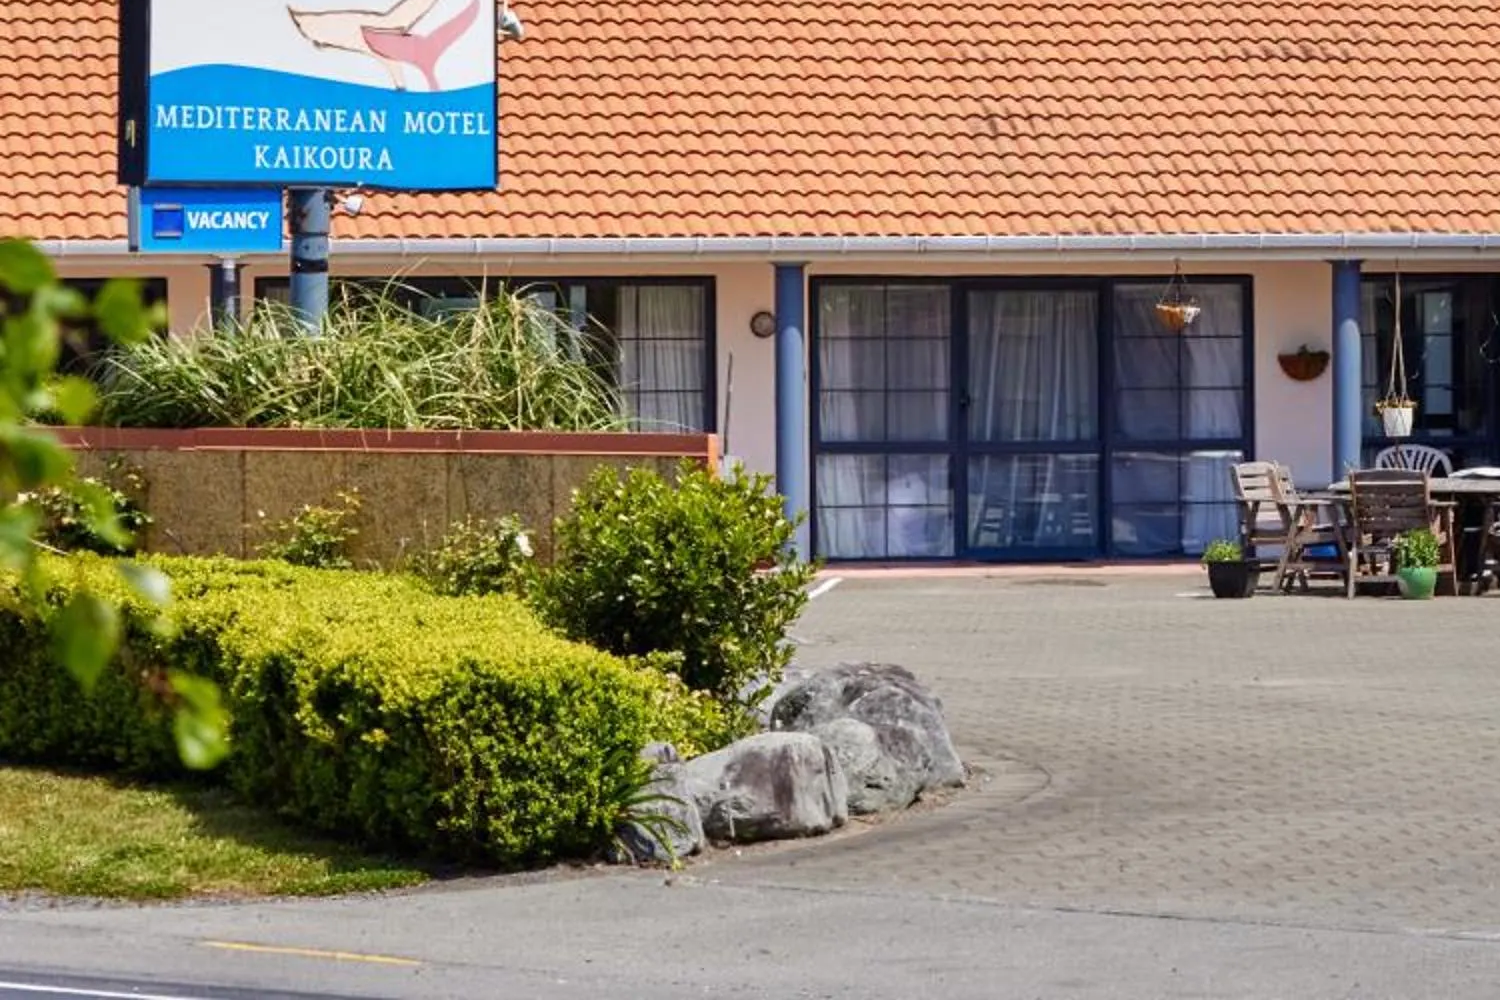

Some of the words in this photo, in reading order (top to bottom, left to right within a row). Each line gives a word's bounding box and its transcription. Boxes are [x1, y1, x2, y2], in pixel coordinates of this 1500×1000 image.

[156, 105, 386, 133] MEDITERRANEAN
[404, 111, 490, 135] MOTEL
[254, 146, 395, 170] KAIKOURA
[187, 211, 270, 230] VACANCY
